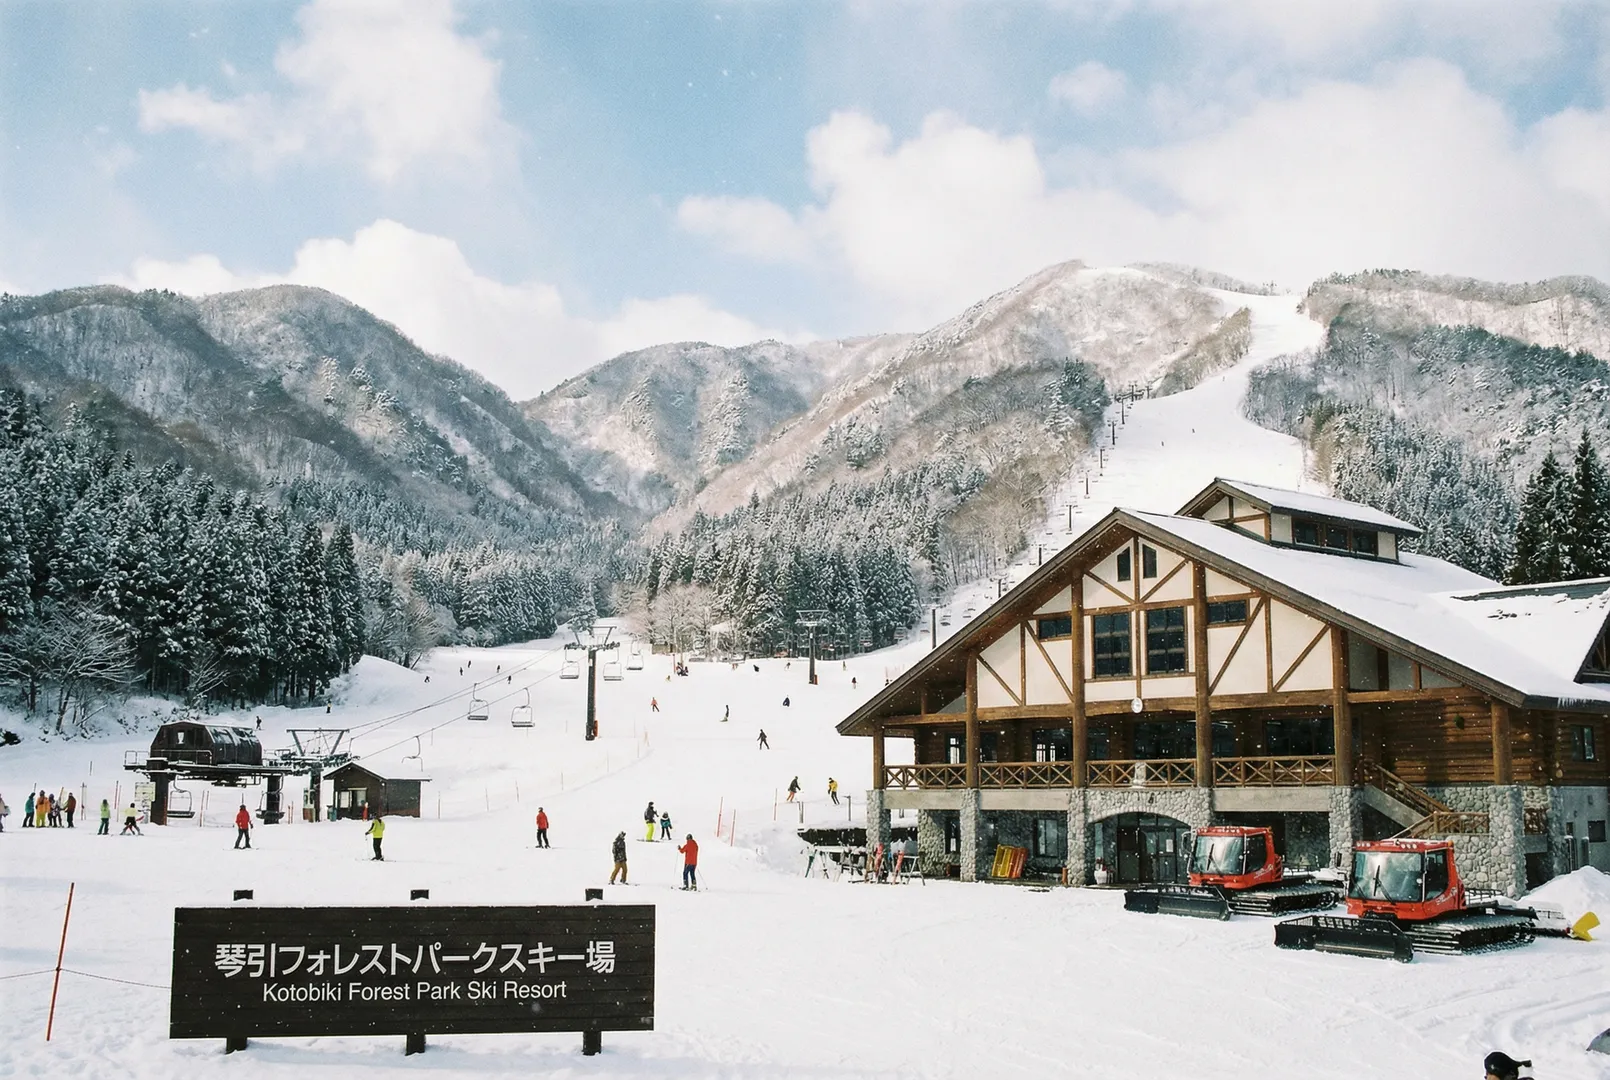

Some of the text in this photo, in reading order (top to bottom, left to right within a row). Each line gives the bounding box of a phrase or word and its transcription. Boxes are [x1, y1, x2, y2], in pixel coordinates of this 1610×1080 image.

[214, 940, 616, 978] 琴引フォレストパークスキー場
[262, 980, 567, 1002] Kotobiki Forest Park Ski Resort
